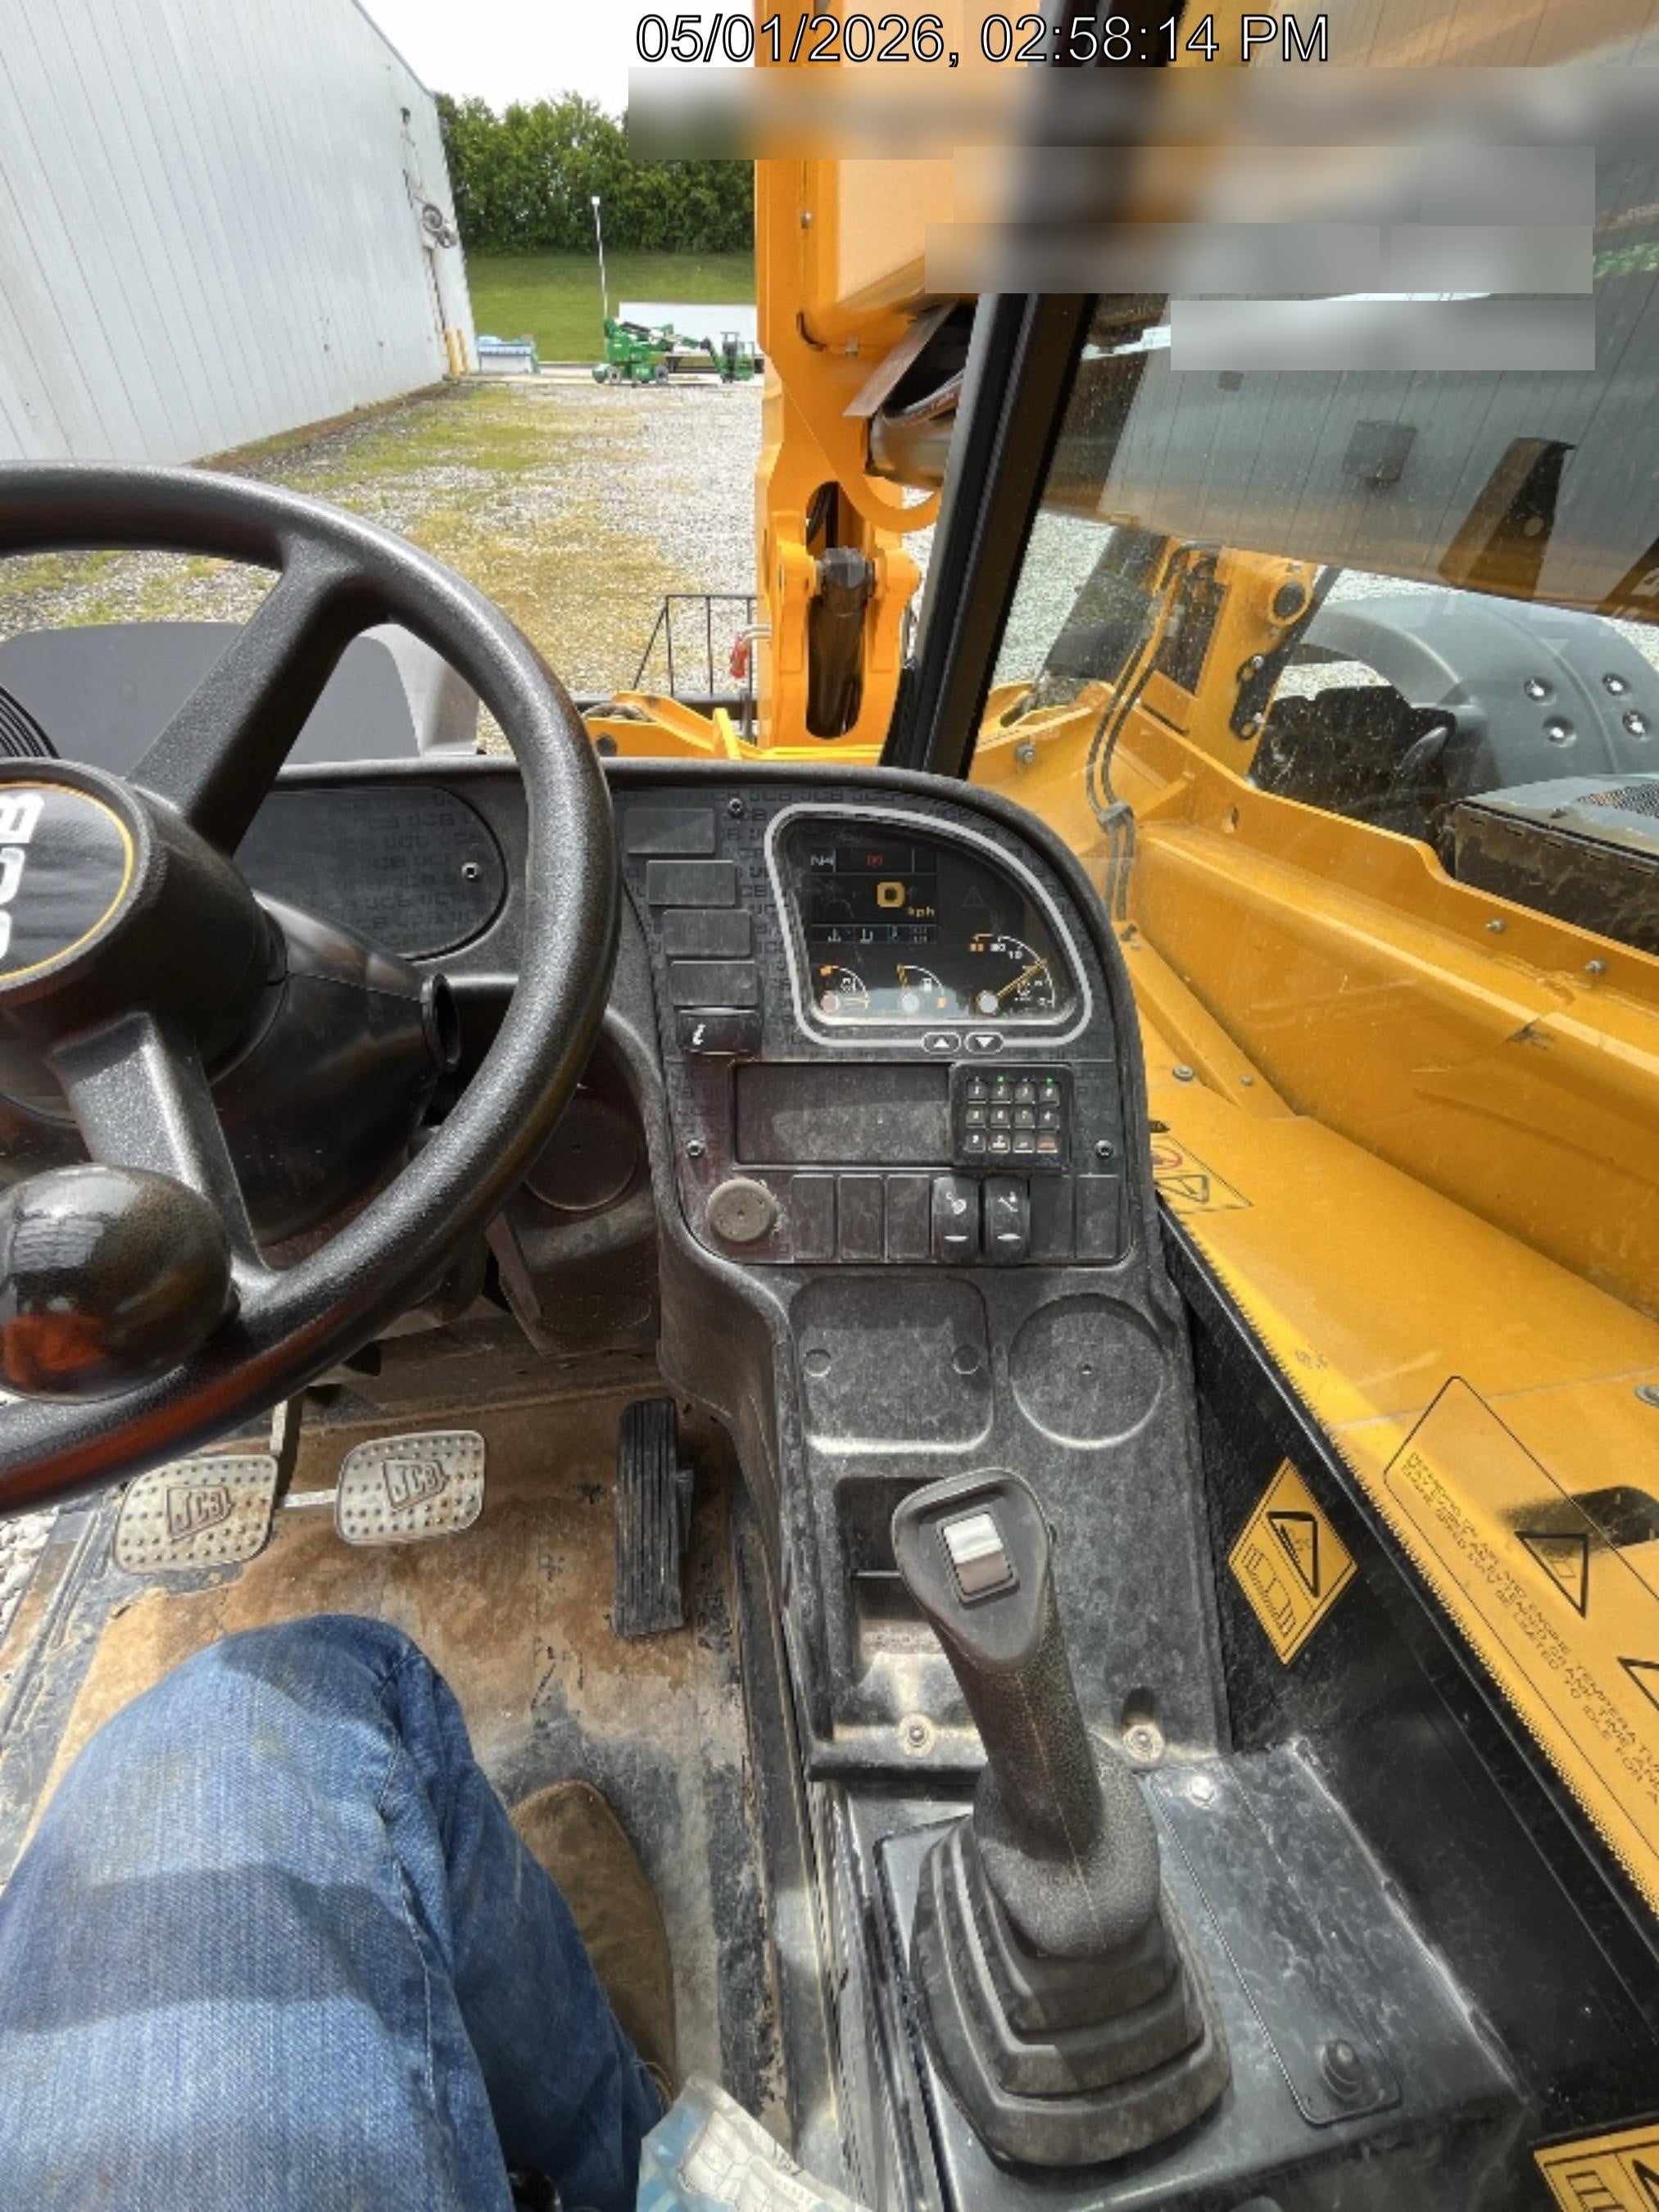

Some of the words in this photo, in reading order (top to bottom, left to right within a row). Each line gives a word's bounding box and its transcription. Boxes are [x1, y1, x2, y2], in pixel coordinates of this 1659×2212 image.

[877, 881, 905, 908] 0
[393, 1461, 440, 1501] JCB
[175, 1489, 222, 1530] JCB
